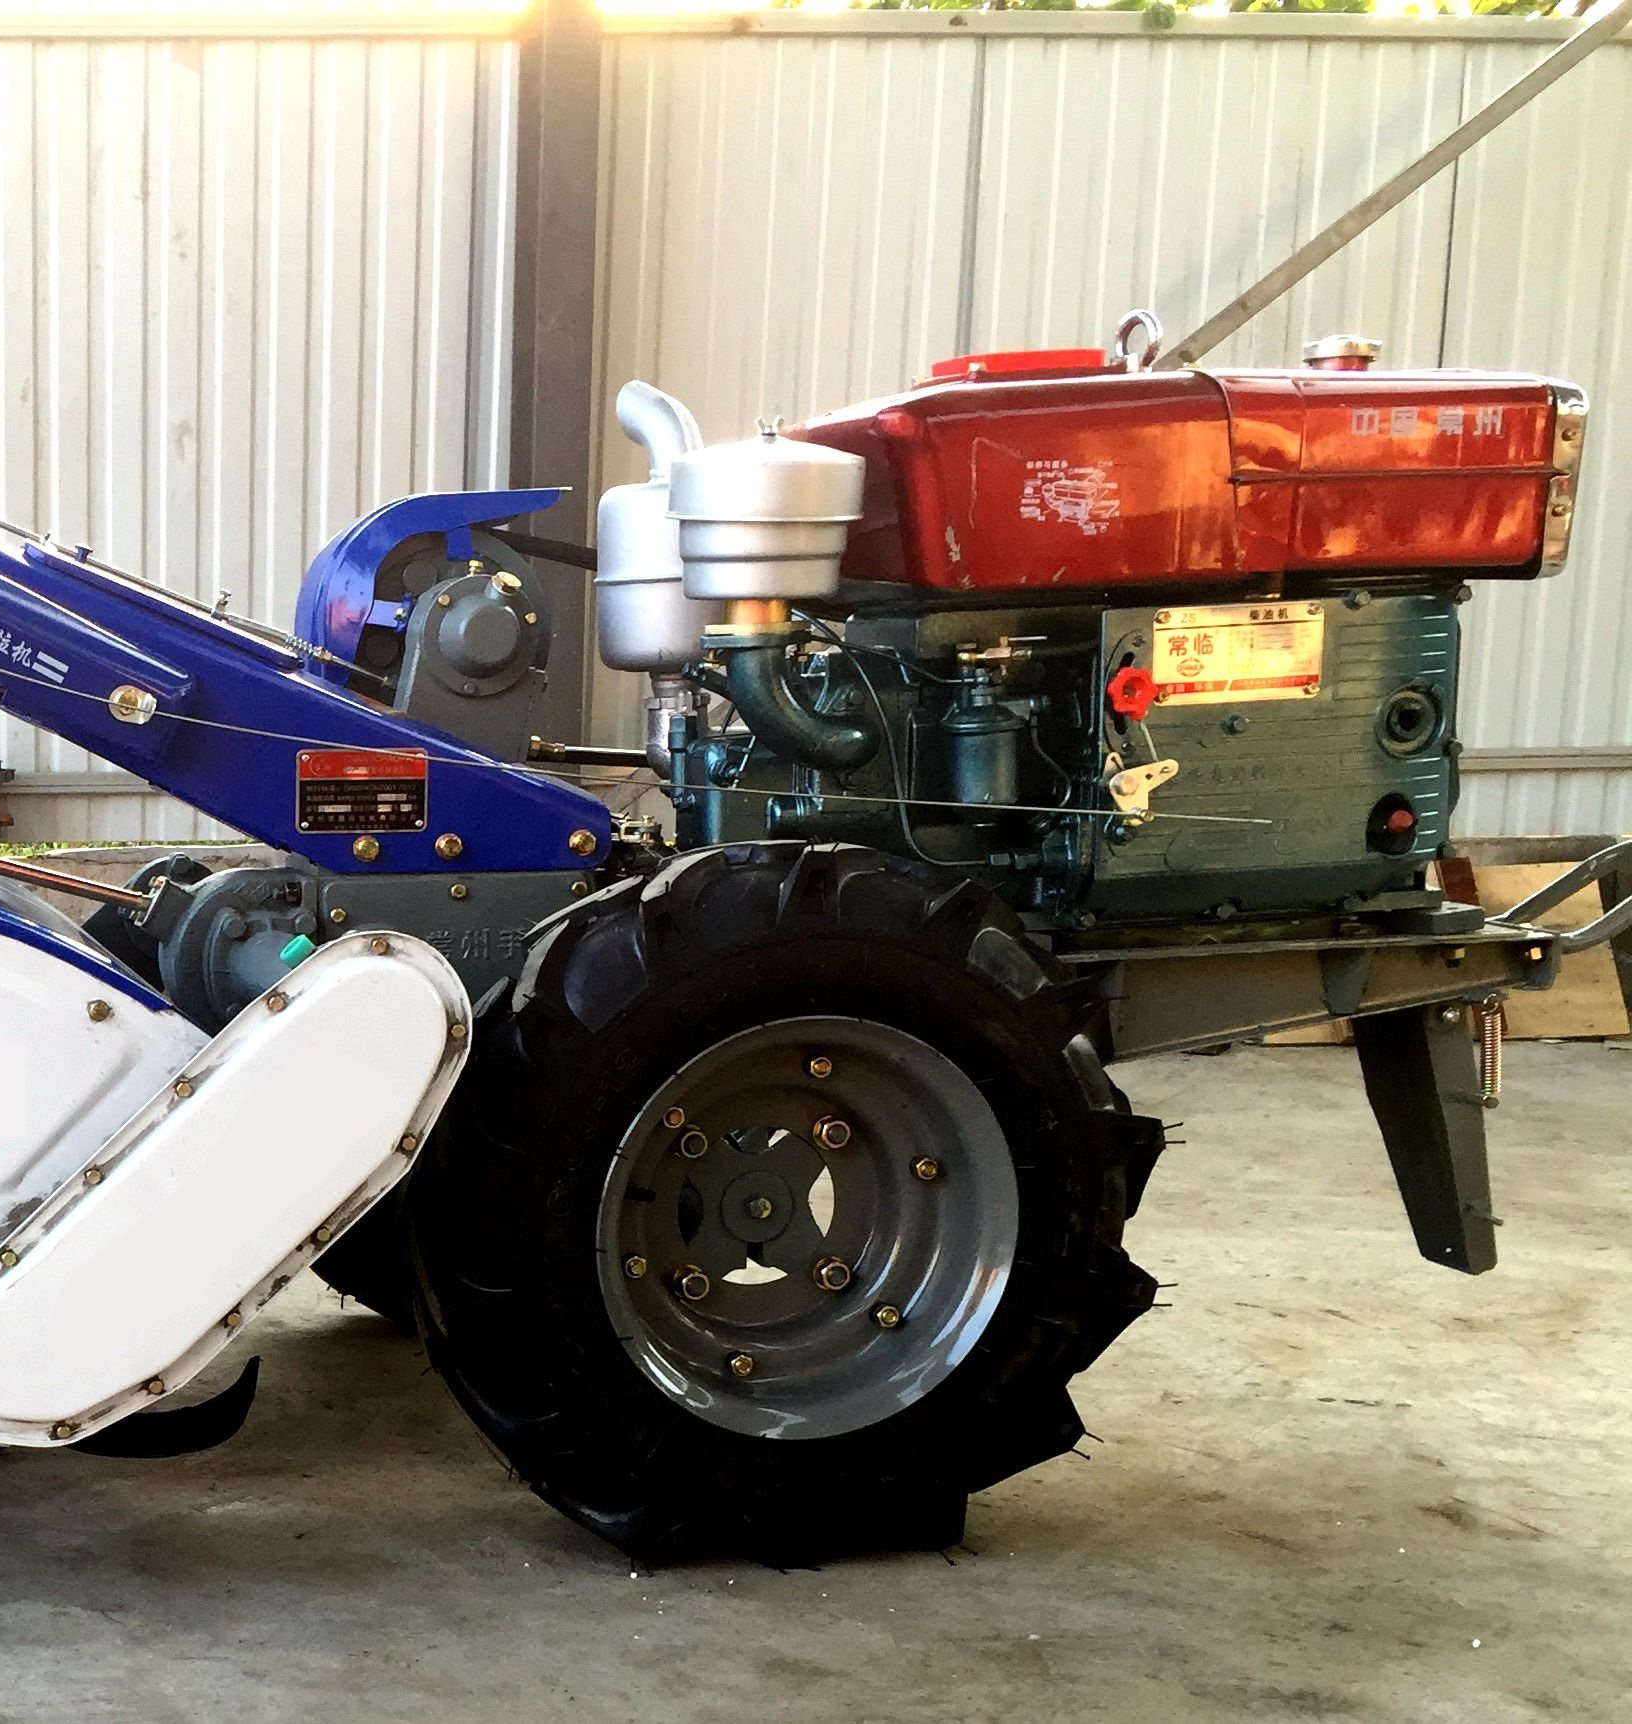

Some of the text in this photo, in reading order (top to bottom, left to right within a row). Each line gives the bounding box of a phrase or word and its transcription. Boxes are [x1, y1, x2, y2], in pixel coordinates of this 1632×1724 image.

[1351, 405, 1505, 437] 中国 常州
[1248, 607, 1289, 621] 柴油机
[1167, 632, 1215, 657] 常临
